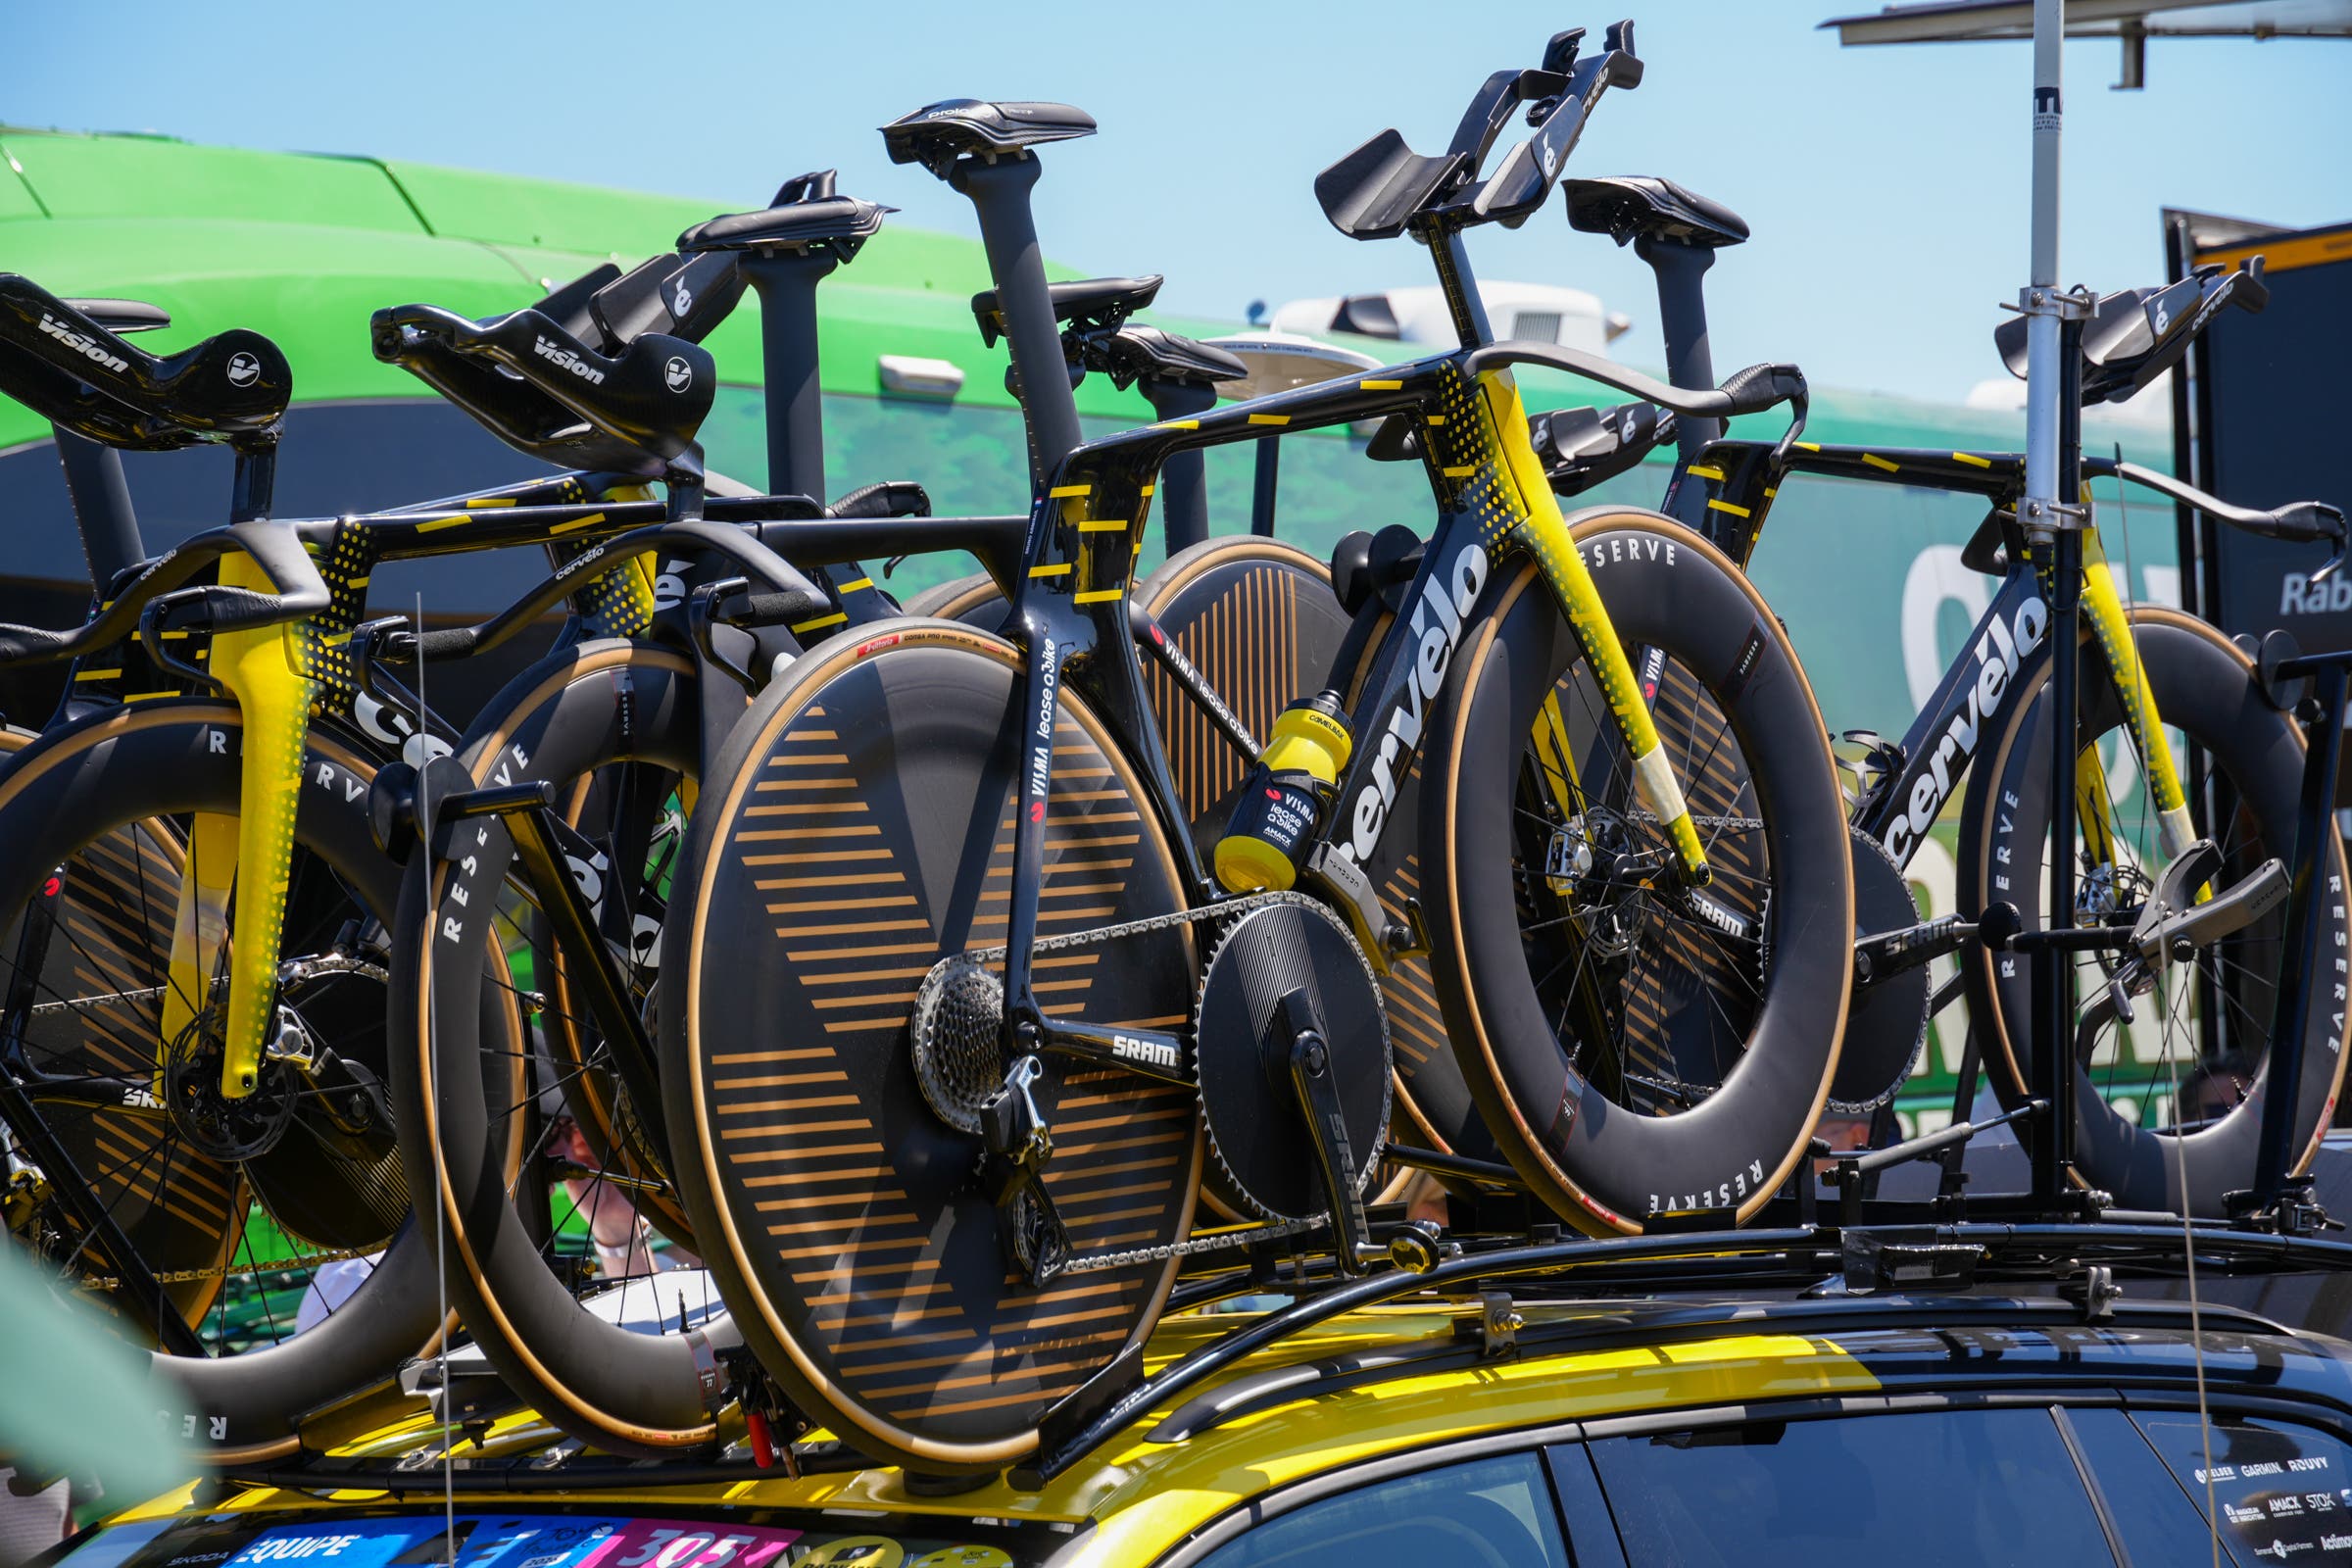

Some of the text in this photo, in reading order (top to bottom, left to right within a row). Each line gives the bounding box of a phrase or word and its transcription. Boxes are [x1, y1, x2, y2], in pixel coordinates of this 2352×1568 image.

[139, 549, 177, 581] cervélo
[555, 547, 605, 581] cervélo
[1165, 640, 1195, 683] VISMA
[1339, 544, 1488, 866] ervélo
[1884, 597, 2048, 870] cervélo
[1032, 747, 1049, 797] VISMA
[1285, 793, 1314, 825] VISMA
[443, 744, 530, 945] RESEVE
[1689, 892, 1743, 938] SRAM
[2328, 874, 2348, 1054] RESERVE
[1112, 1035, 1176, 1066] SRAM
[2240, 1461, 2283, 1478] GARMIN
[2286, 1456, 2329, 1472] ROUVY
[2268, 1495, 2302, 1512] AMACX
[2305, 1493, 2336, 1509] STOX
[616, 1529, 758, 1568] 305
